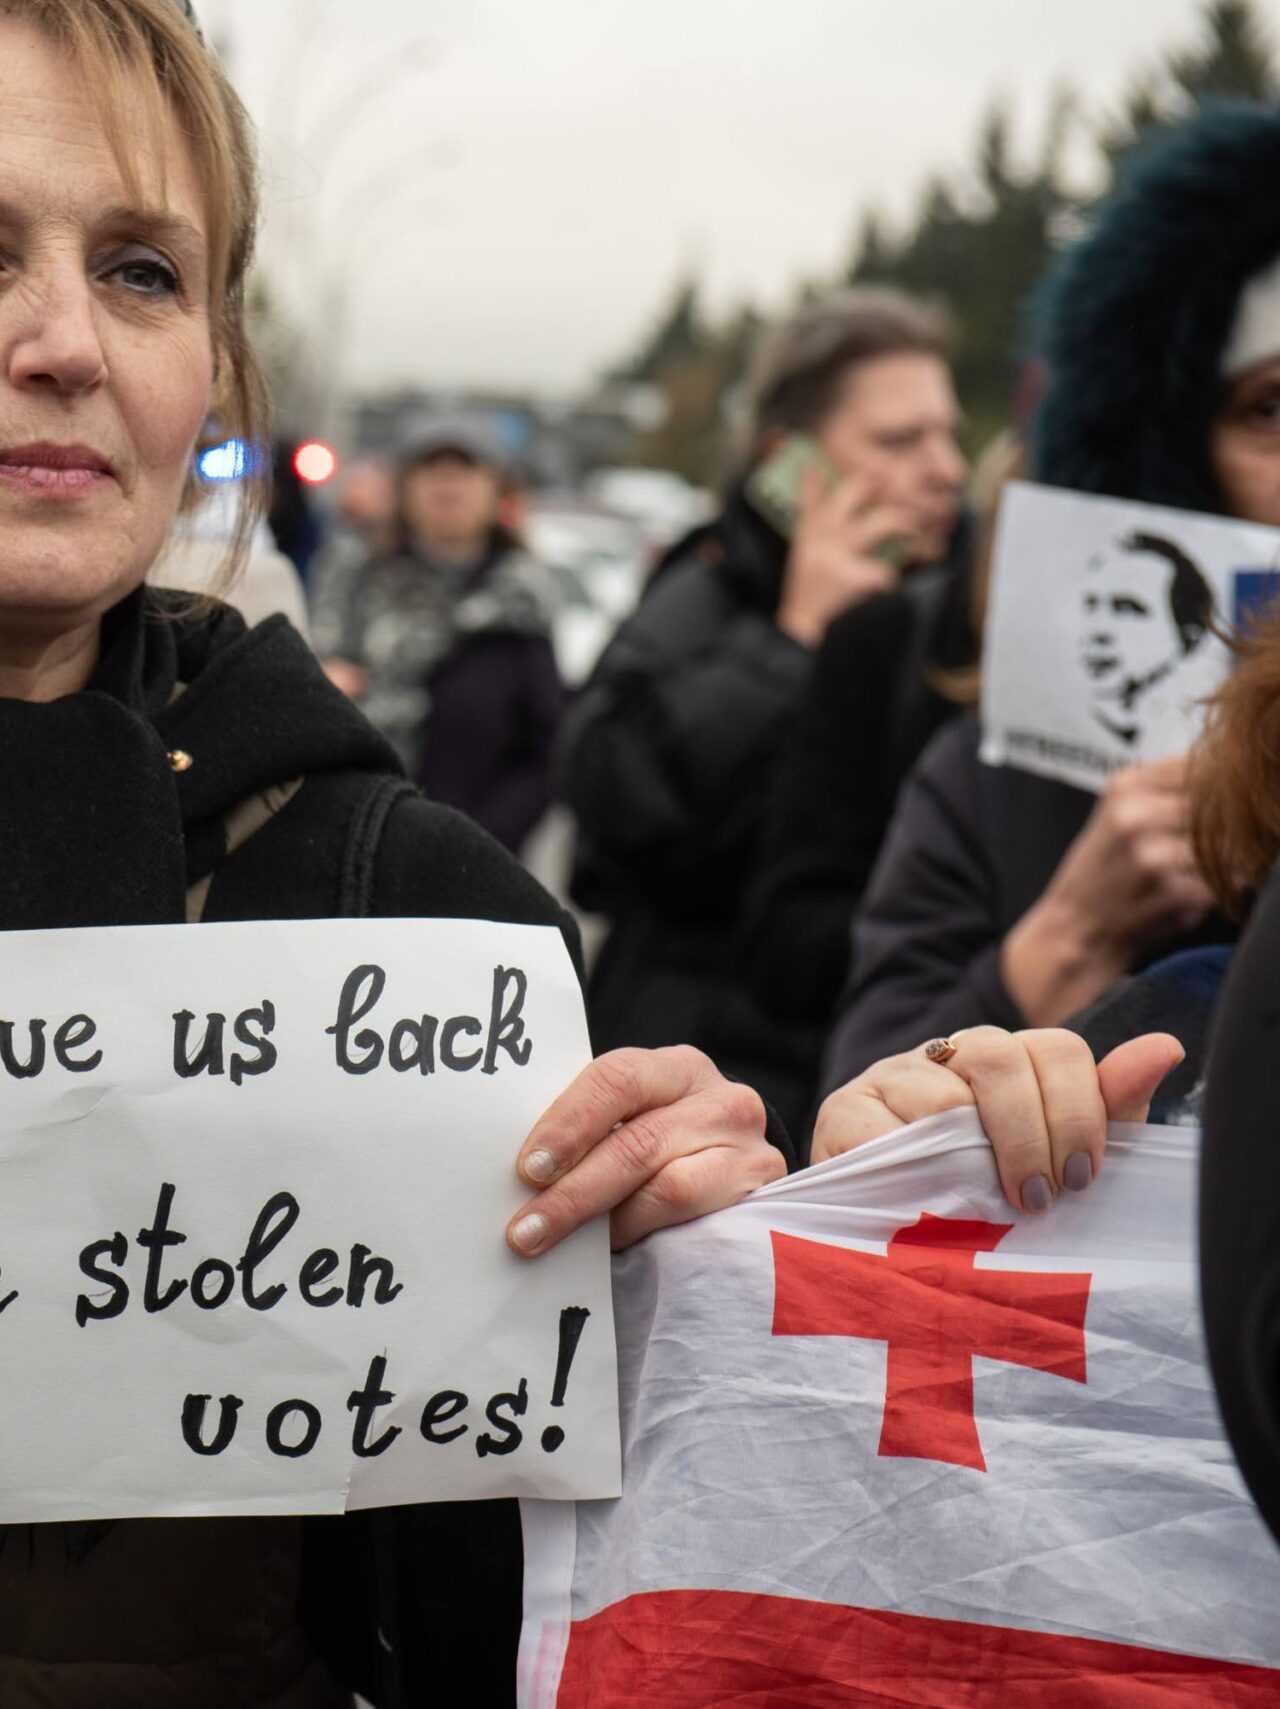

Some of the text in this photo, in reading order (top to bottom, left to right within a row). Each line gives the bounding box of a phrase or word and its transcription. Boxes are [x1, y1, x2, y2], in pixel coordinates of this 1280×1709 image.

[171, 999, 278, 1087] us
[324, 964, 532, 1077] back
[74, 1182, 404, 1328] stolen
[180, 1304, 591, 1459] votes!
